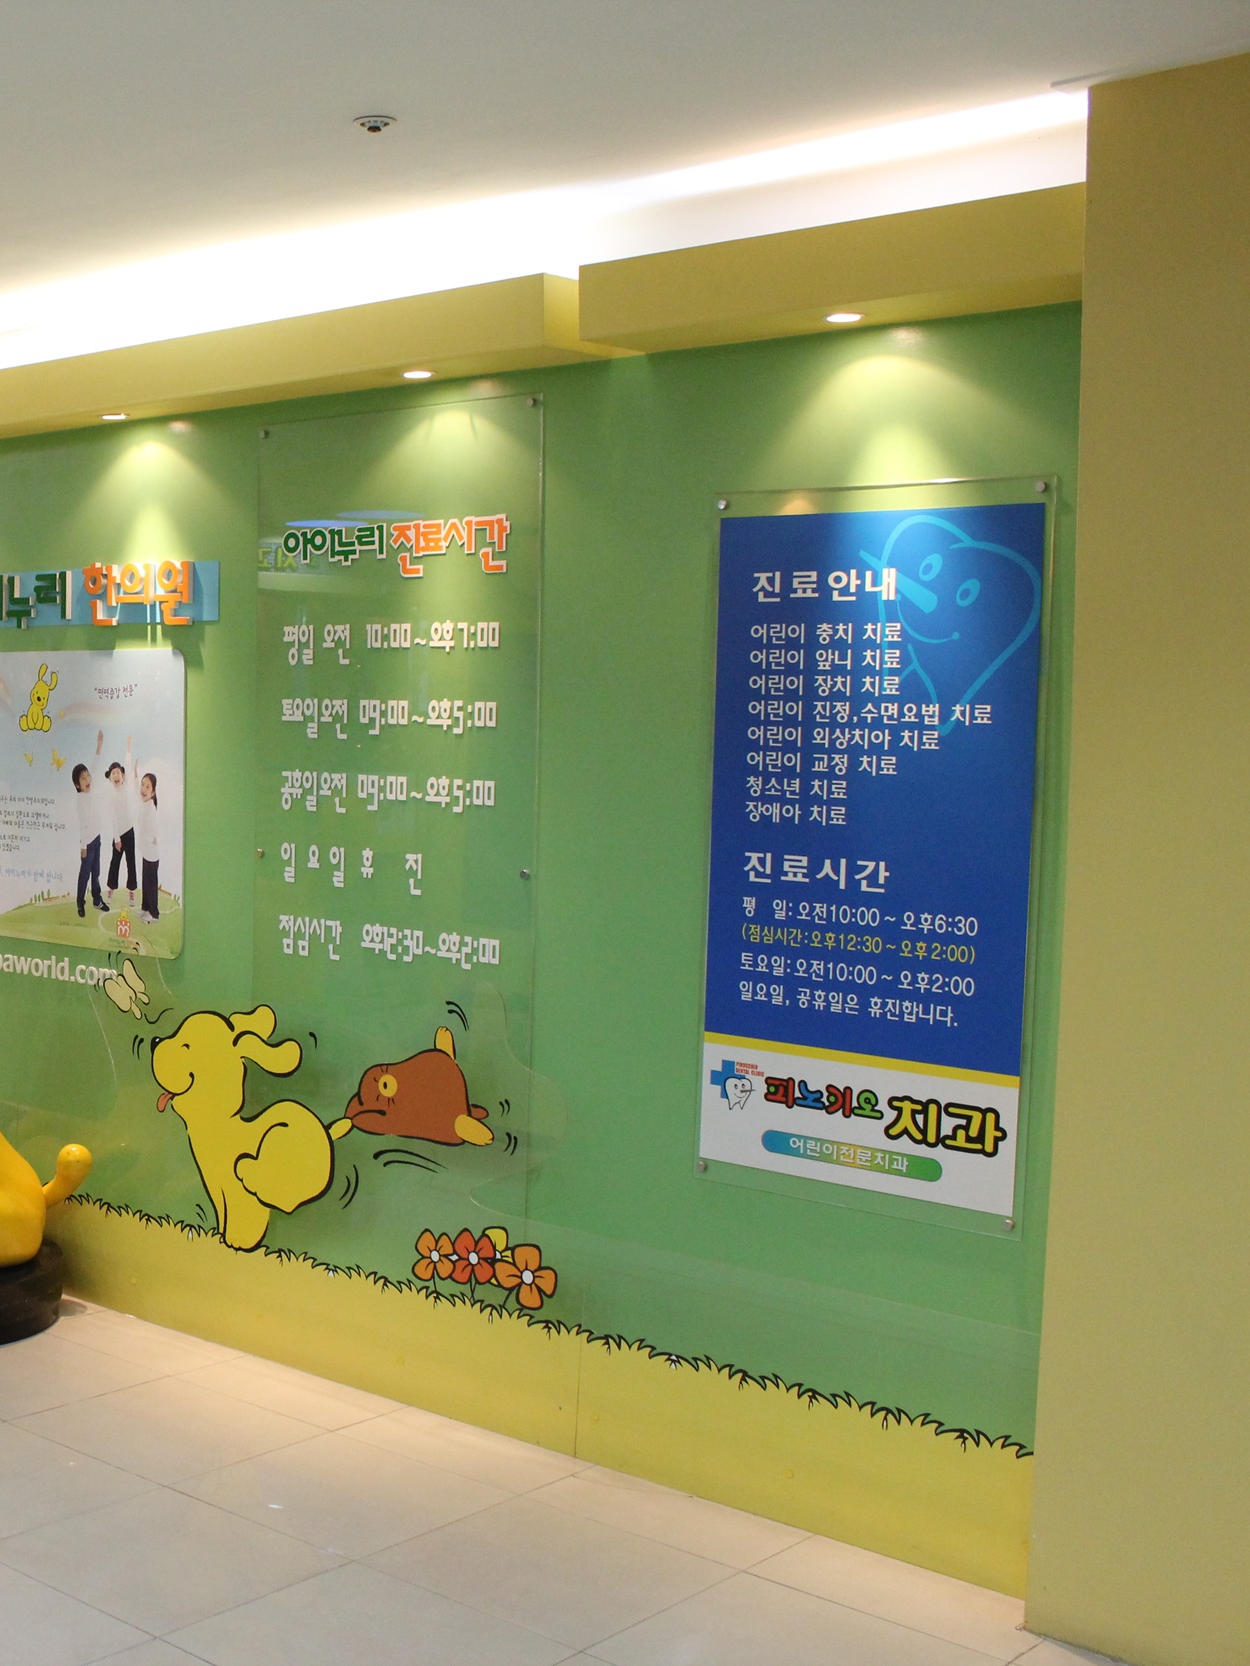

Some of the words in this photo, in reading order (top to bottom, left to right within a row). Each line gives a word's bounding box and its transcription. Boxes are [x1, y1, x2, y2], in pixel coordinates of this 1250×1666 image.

[282, 523, 386, 565] 아이누리
[390, 513, 510, 578] 진료시간
[82, 560, 193, 626] 한의원
[752, 567, 897, 603] 진료안내
[283, 624, 314, 665] 평일
[322, 623, 350, 665] 오전
[750, 623, 805, 644] 어린이
[816, 623, 852, 644] 충치
[862, 622, 902, 643] 치료
[750, 649, 804, 670] 어린이
[815, 649, 852, 670] 앞니
[861, 649, 901, 670] 치료
[749, 675, 803, 696] 어린이
[814, 675, 851, 696] 장치
[861, 675, 901, 696] 치료
[748, 701, 803, 721] 어린이
[950, 704, 992, 725] 치료
[747, 726, 802, 747] 어린이
[812, 728, 892, 750] 외상치아
[900, 729, 939, 751] 치료
[746, 751, 801, 772] 어린이
[811, 754, 849, 775] 교정
[858, 755, 898, 776] 치료
[746, 776, 800, 799] 청소년
[809, 779, 848, 800] 치료
[746, 801, 801, 823] 장애아
[809, 805, 847, 825] 치료
[743, 852, 890, 893] 진료시간
[279, 915, 342, 961] 점심시간
[796, 988, 859, 1014] 공휴일은
[867, 996, 958, 1027] 휴진합니다.
[764, 1076, 884, 1120] 피노키오
[884, 1096, 1007, 1157] 치과
[790, 1136, 909, 1173] 어린이전문치과
